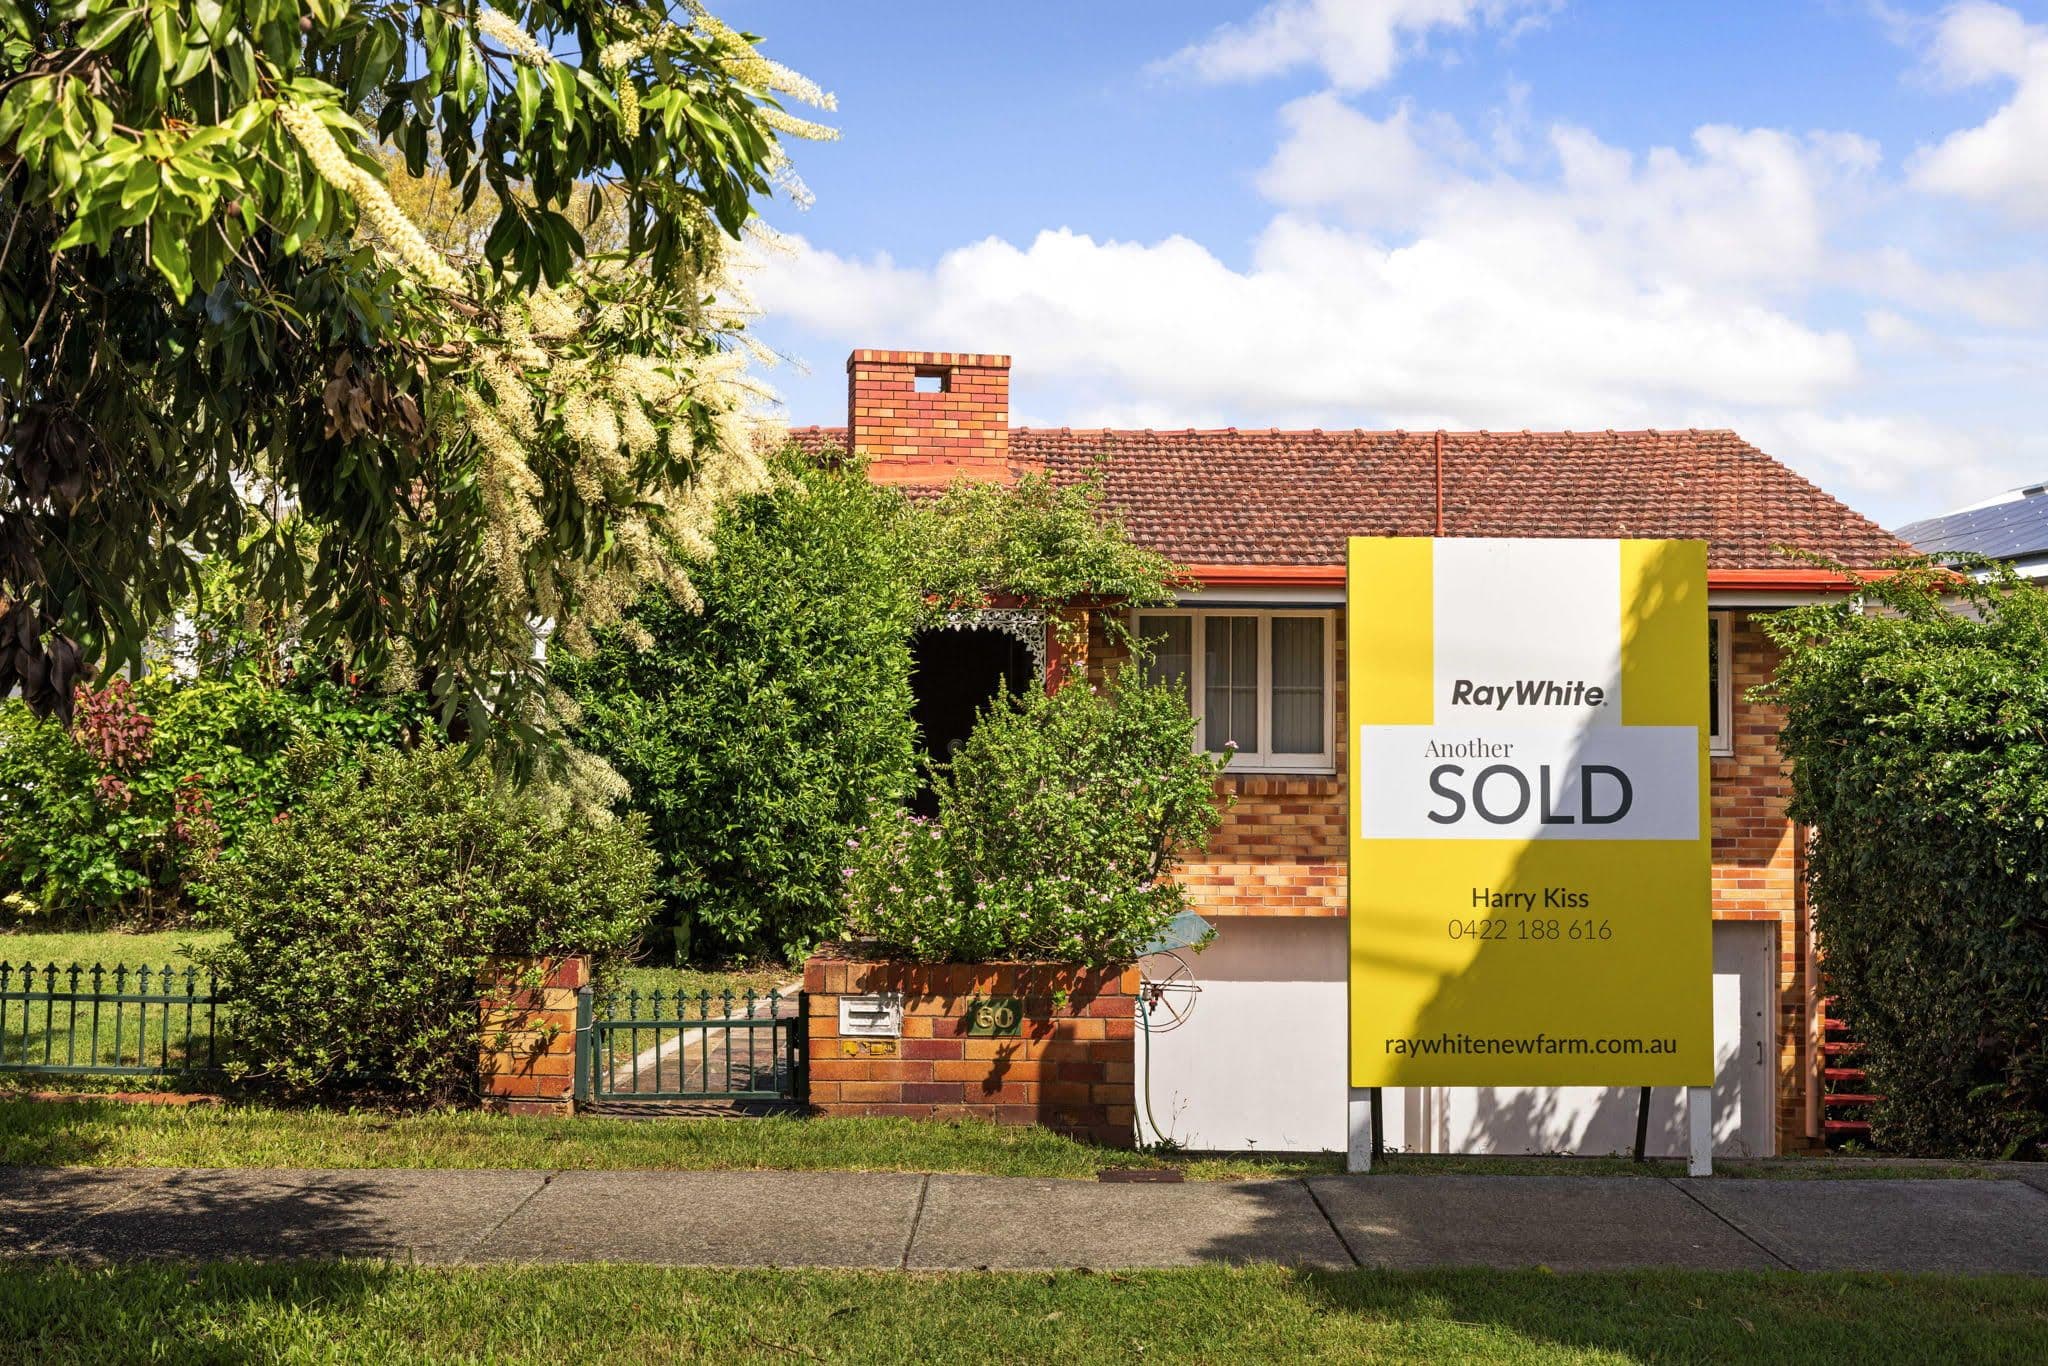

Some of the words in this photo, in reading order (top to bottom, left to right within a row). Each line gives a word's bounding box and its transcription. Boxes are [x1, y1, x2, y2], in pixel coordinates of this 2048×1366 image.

[1424, 737, 1514, 759] Another
[1427, 763, 1633, 825] SOLD
[1472, 887, 1537, 912] Harry
[1544, 887, 1590, 909] Kiss
[1448, 919, 1508, 940] 0422
[1517, 919, 1561, 940] 188
[1568, 919, 1613, 940] 616
[976, 1006, 1014, 1028] 60
[1385, 1033, 1677, 1058] raywhitenewfarm.com.au
